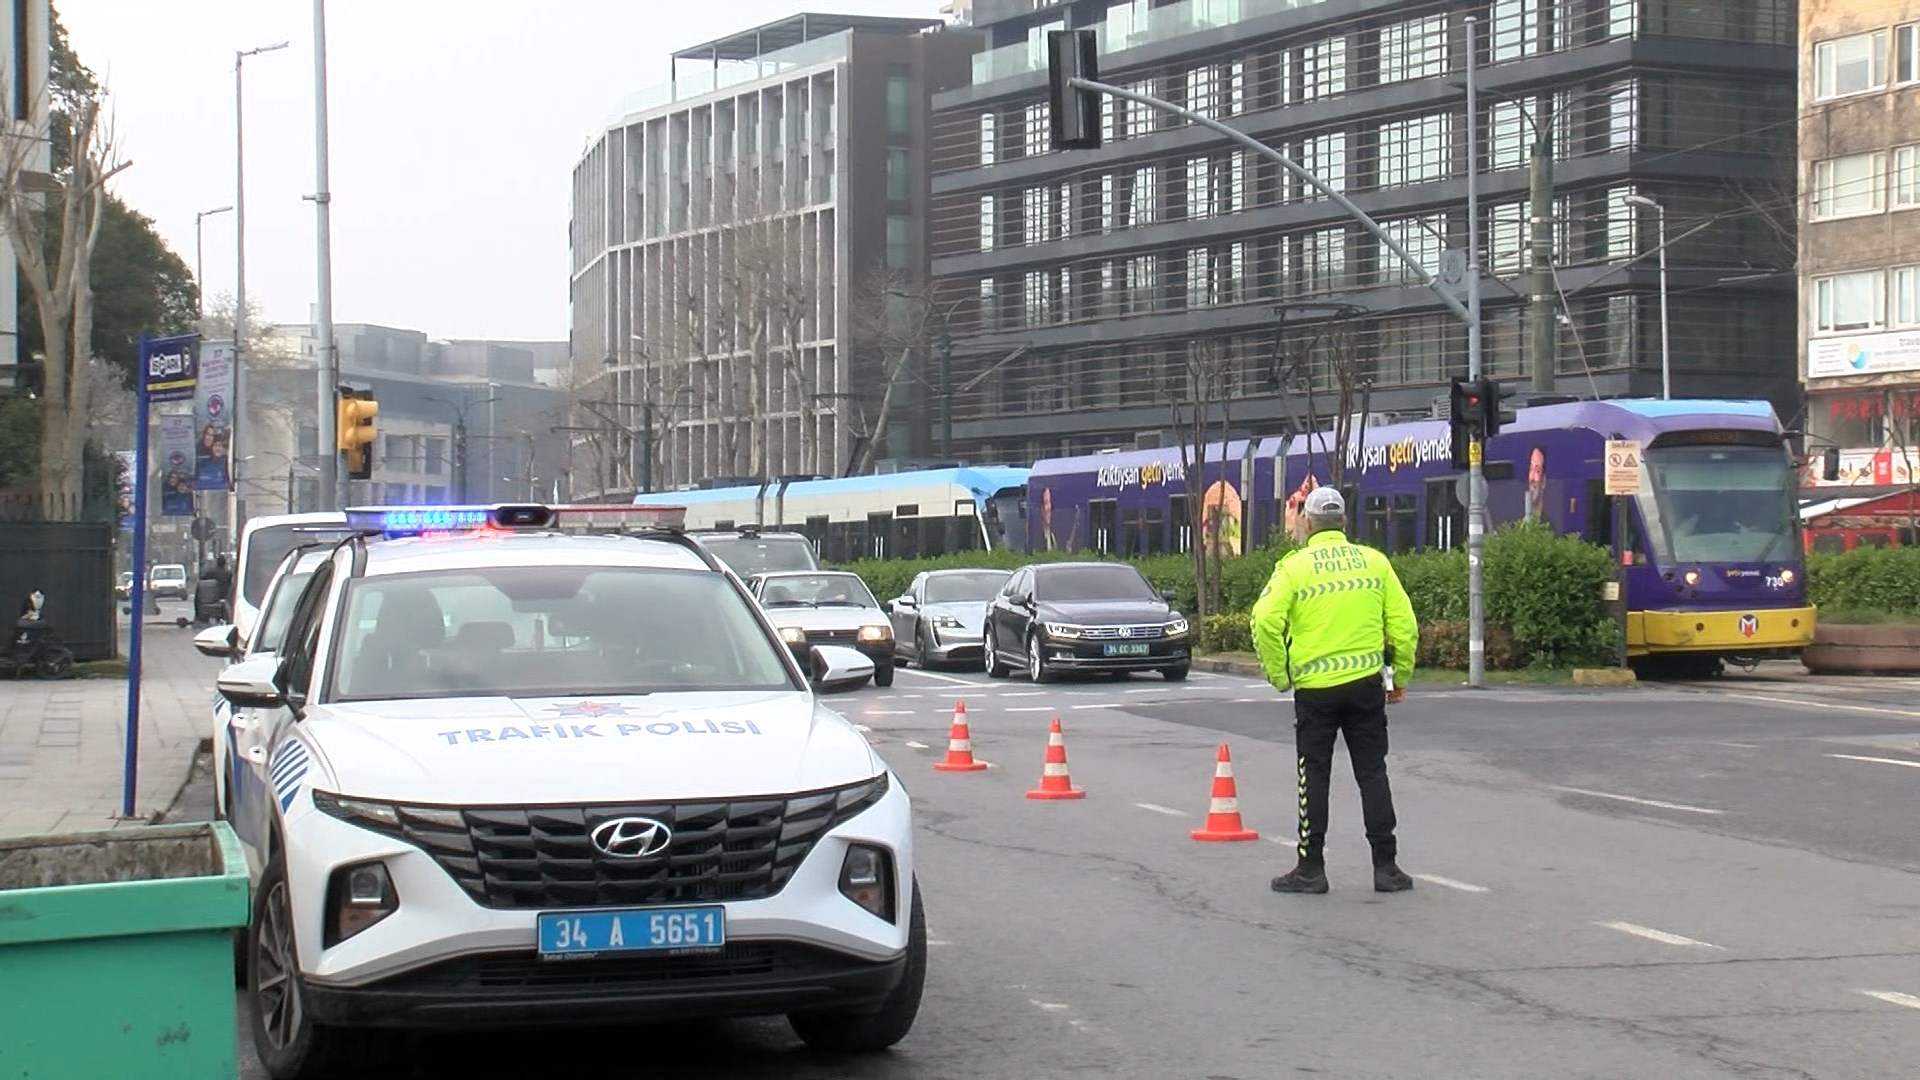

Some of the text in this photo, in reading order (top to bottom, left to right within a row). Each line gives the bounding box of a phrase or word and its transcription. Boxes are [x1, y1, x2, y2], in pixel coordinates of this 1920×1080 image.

[555, 912, 715, 948] 34 A 5651
